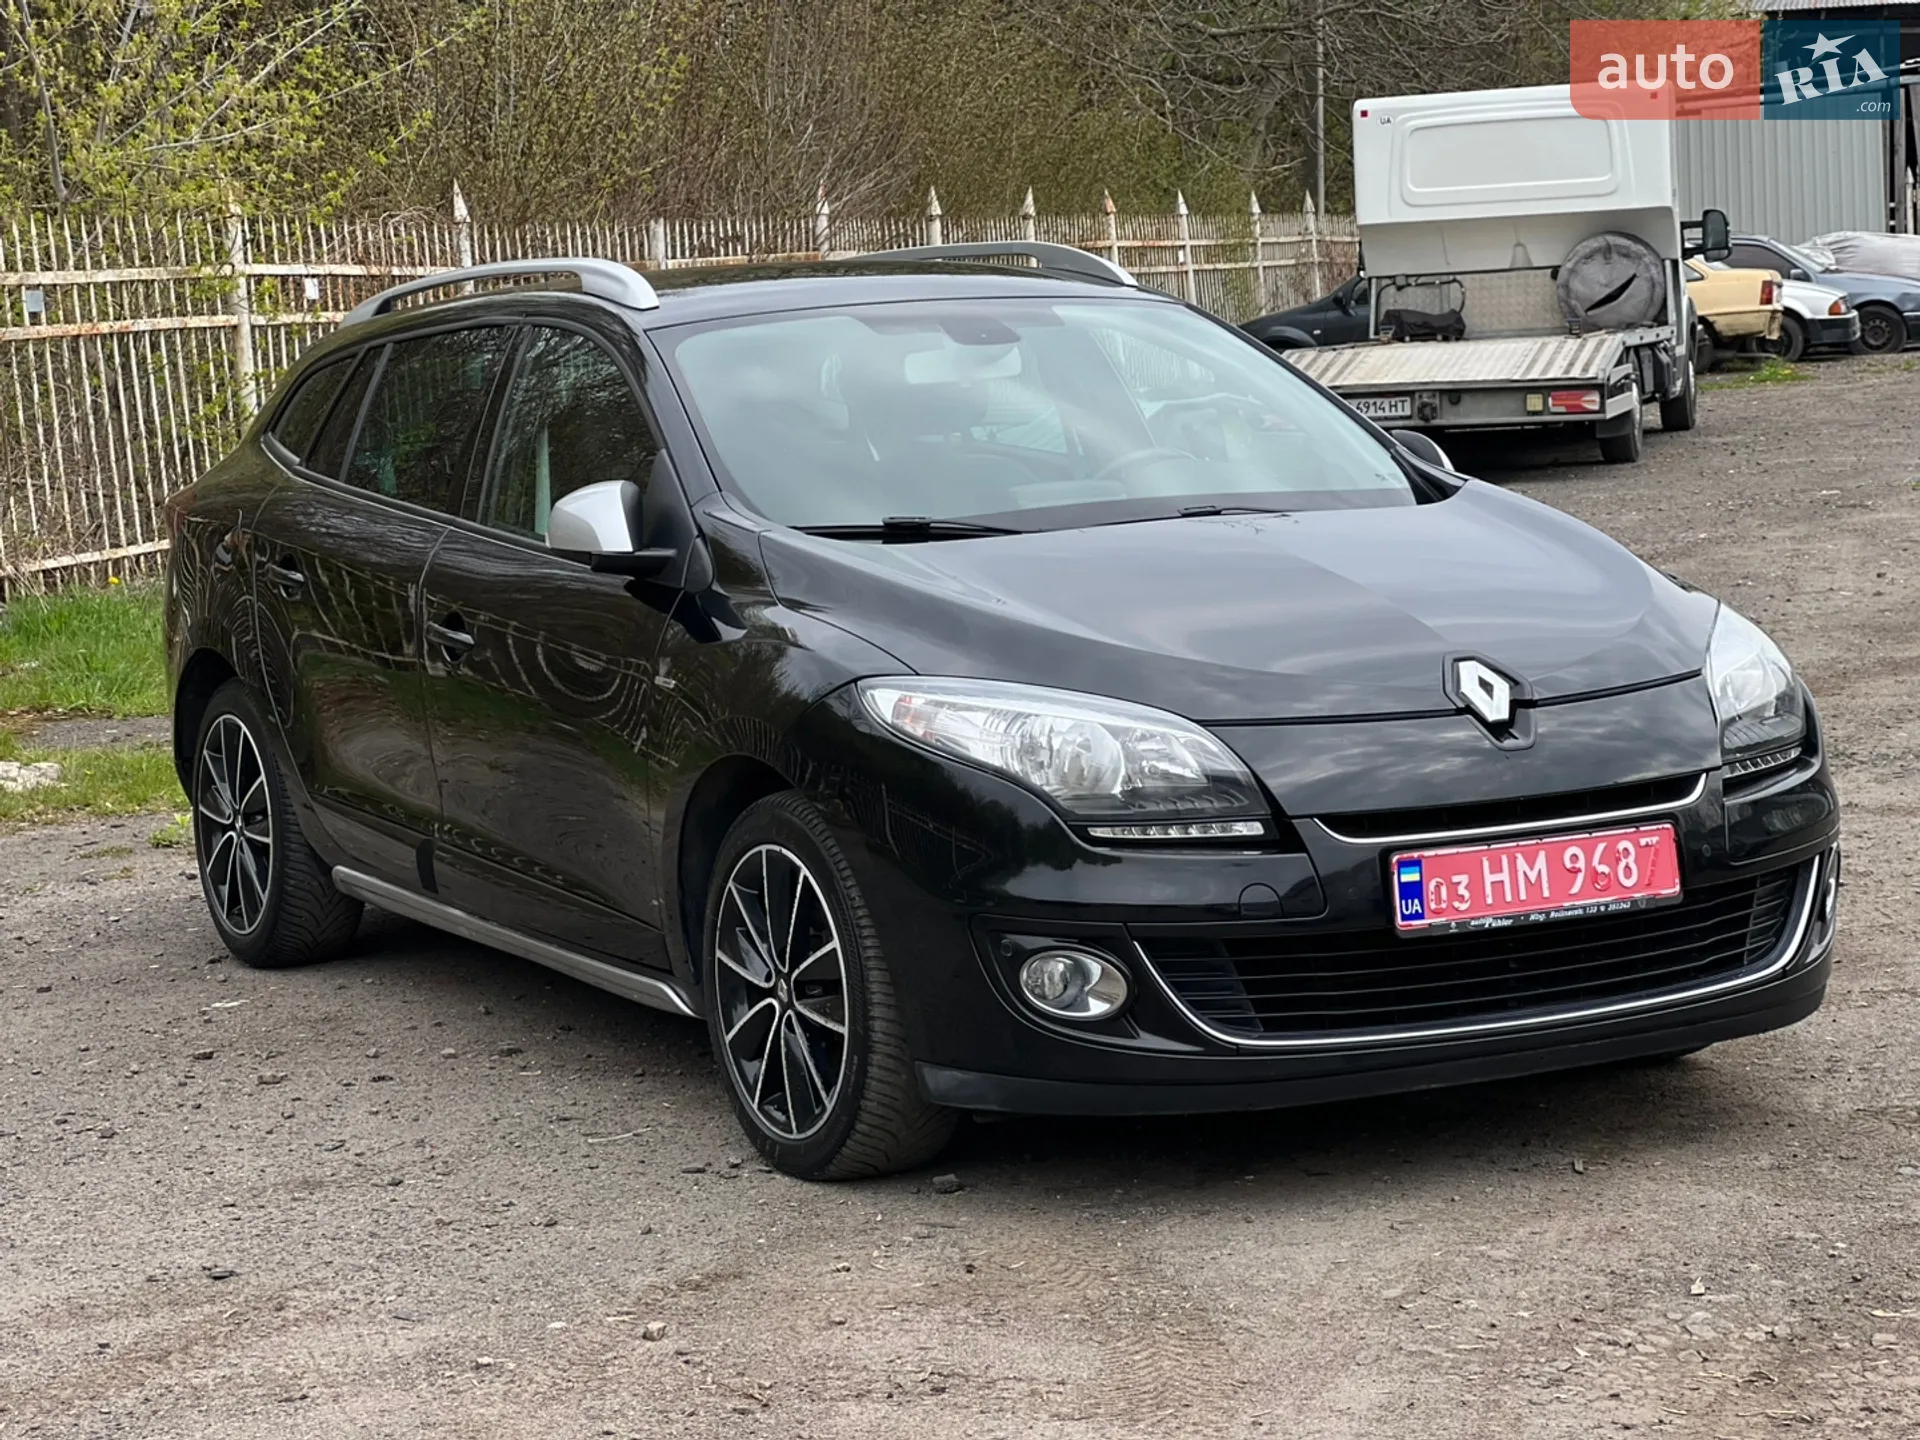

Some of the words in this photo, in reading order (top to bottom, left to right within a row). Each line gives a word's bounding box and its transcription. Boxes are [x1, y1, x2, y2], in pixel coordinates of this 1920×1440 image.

[1390, 400, 1408, 413] HT
[1429, 874, 1471, 914] 03
[1482, 851, 1550, 905] HM
[1563, 837, 1660, 896] 9687
[1401, 899, 1422, 915] UA
